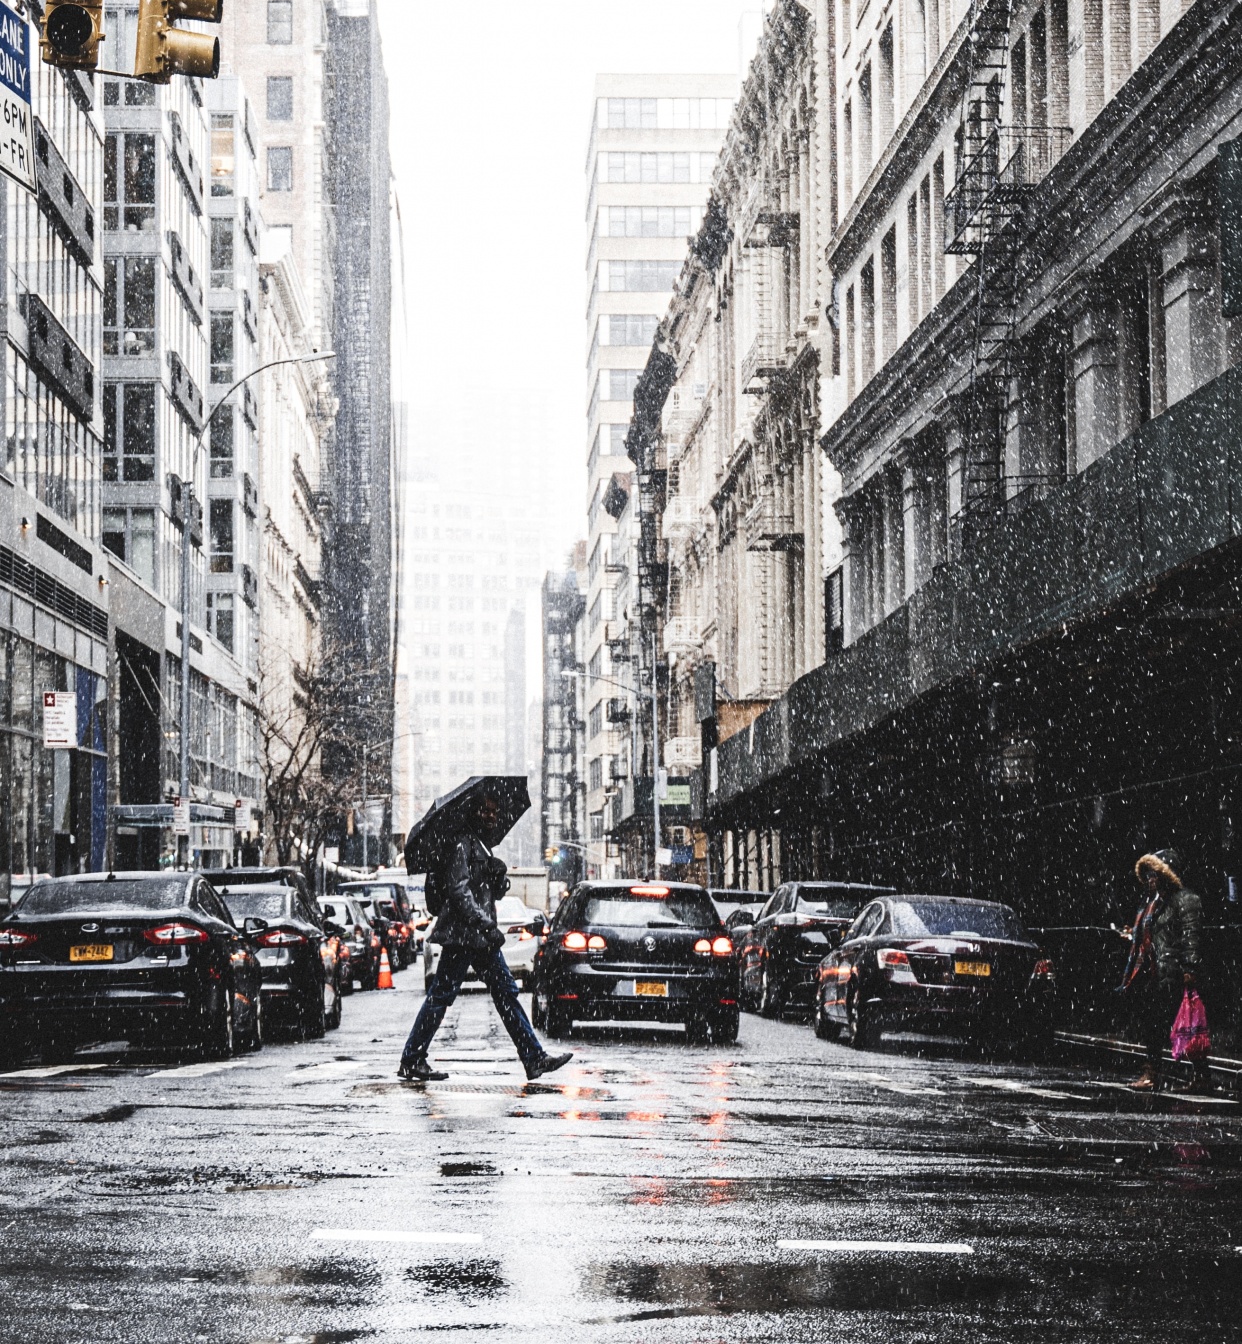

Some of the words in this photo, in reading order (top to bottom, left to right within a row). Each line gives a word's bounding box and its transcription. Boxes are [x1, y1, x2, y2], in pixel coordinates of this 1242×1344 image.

[0, 14, 25, 56] ANE
[0, 47, 27, 92] ONLY
[0, 99, 28, 137] 6PM
[0, 137, 30, 175] -FRI
